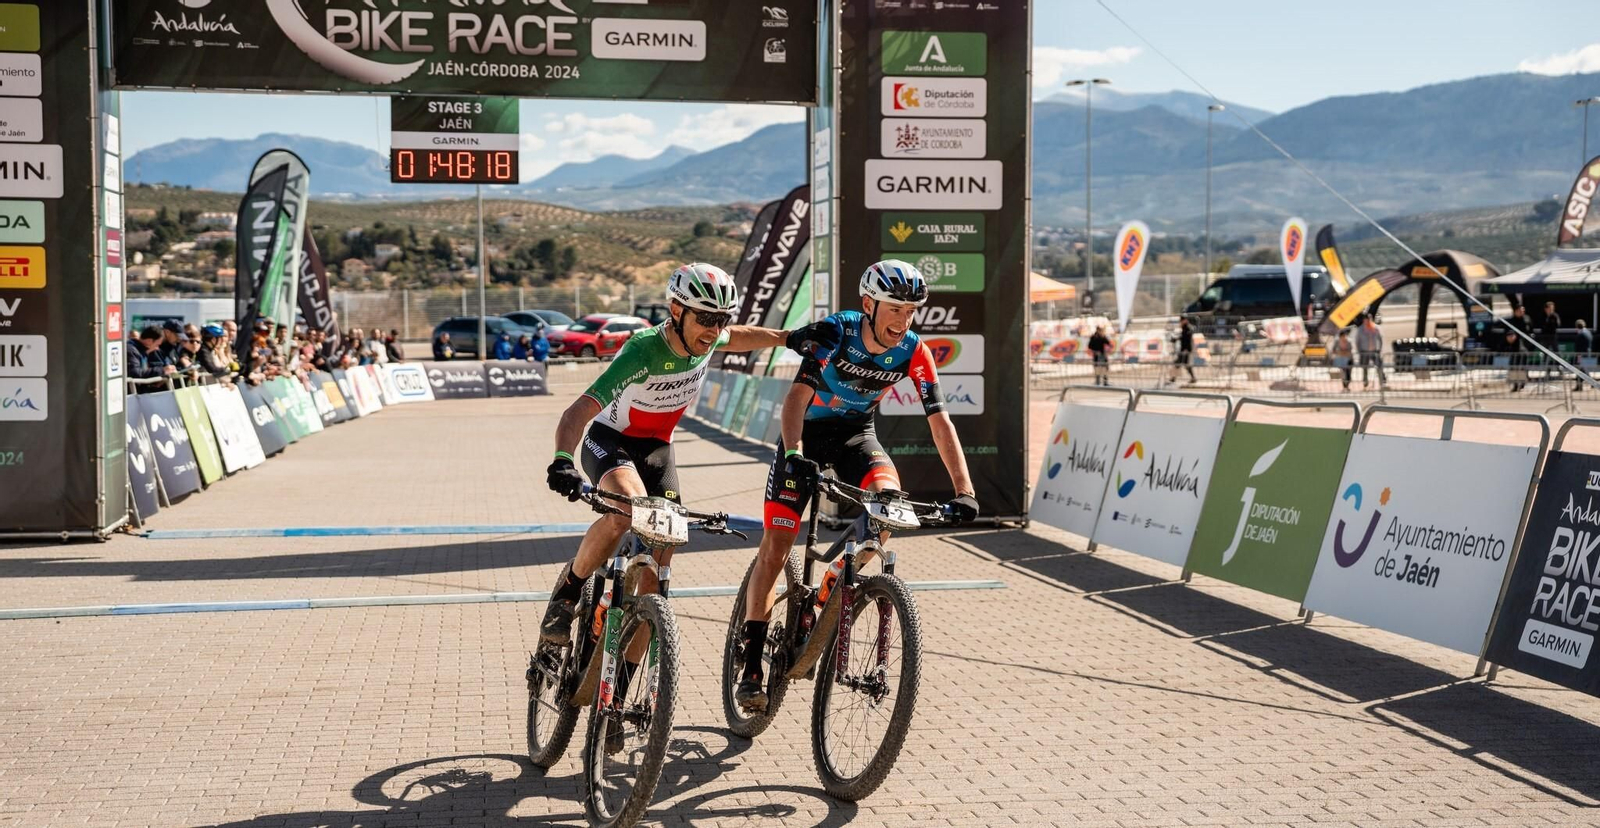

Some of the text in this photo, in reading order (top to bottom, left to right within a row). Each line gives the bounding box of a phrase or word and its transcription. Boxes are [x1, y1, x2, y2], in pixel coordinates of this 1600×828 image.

[151, 10, 241, 35] Andalucía
[326, 9, 434, 52] BIKE
[448, 13, 579, 57] RACE
[605, 31, 694, 48] GARMIN
[544, 65, 581, 79] 2024
[924, 89, 974, 99] Diputación
[937, 99, 975, 109] Córdoba
[428, 101, 482, 114] STAGE 3
[439, 118, 472, 130] JAÉN
[921, 128, 973, 138] AYUNTAMIENTO
[432, 137, 479, 146] GARMIN
[921, 140, 930, 149] DE
[877, 175, 987, 194] GARMIN
[917, 224, 977, 234] CAJA RURAL
[934, 233, 959, 243] JAÉN
[622, 366, 649, 388] KENDA
[836, 358, 904, 382] TORPADO
[886, 384, 978, 407] Ancía
[1143, 452, 1199, 499] Andalucía
[880, 505, 906, 522] 4-2
[1250, 502, 1301, 526] DIPUTACIÓN
[1560, 491, 1600, 526] Anda
[648, 510, 673, 535] 4-1
[1244, 524, 1279, 544] DE JAÉN
[1383, 516, 1505, 562] Ayuntamiento
[1374, 549, 1441, 588] de Jaén
[1530, 575, 1600, 632] RACE
[1528, 629, 1582, 658] GARMIN
[604, 628, 620, 694] MANITOU
